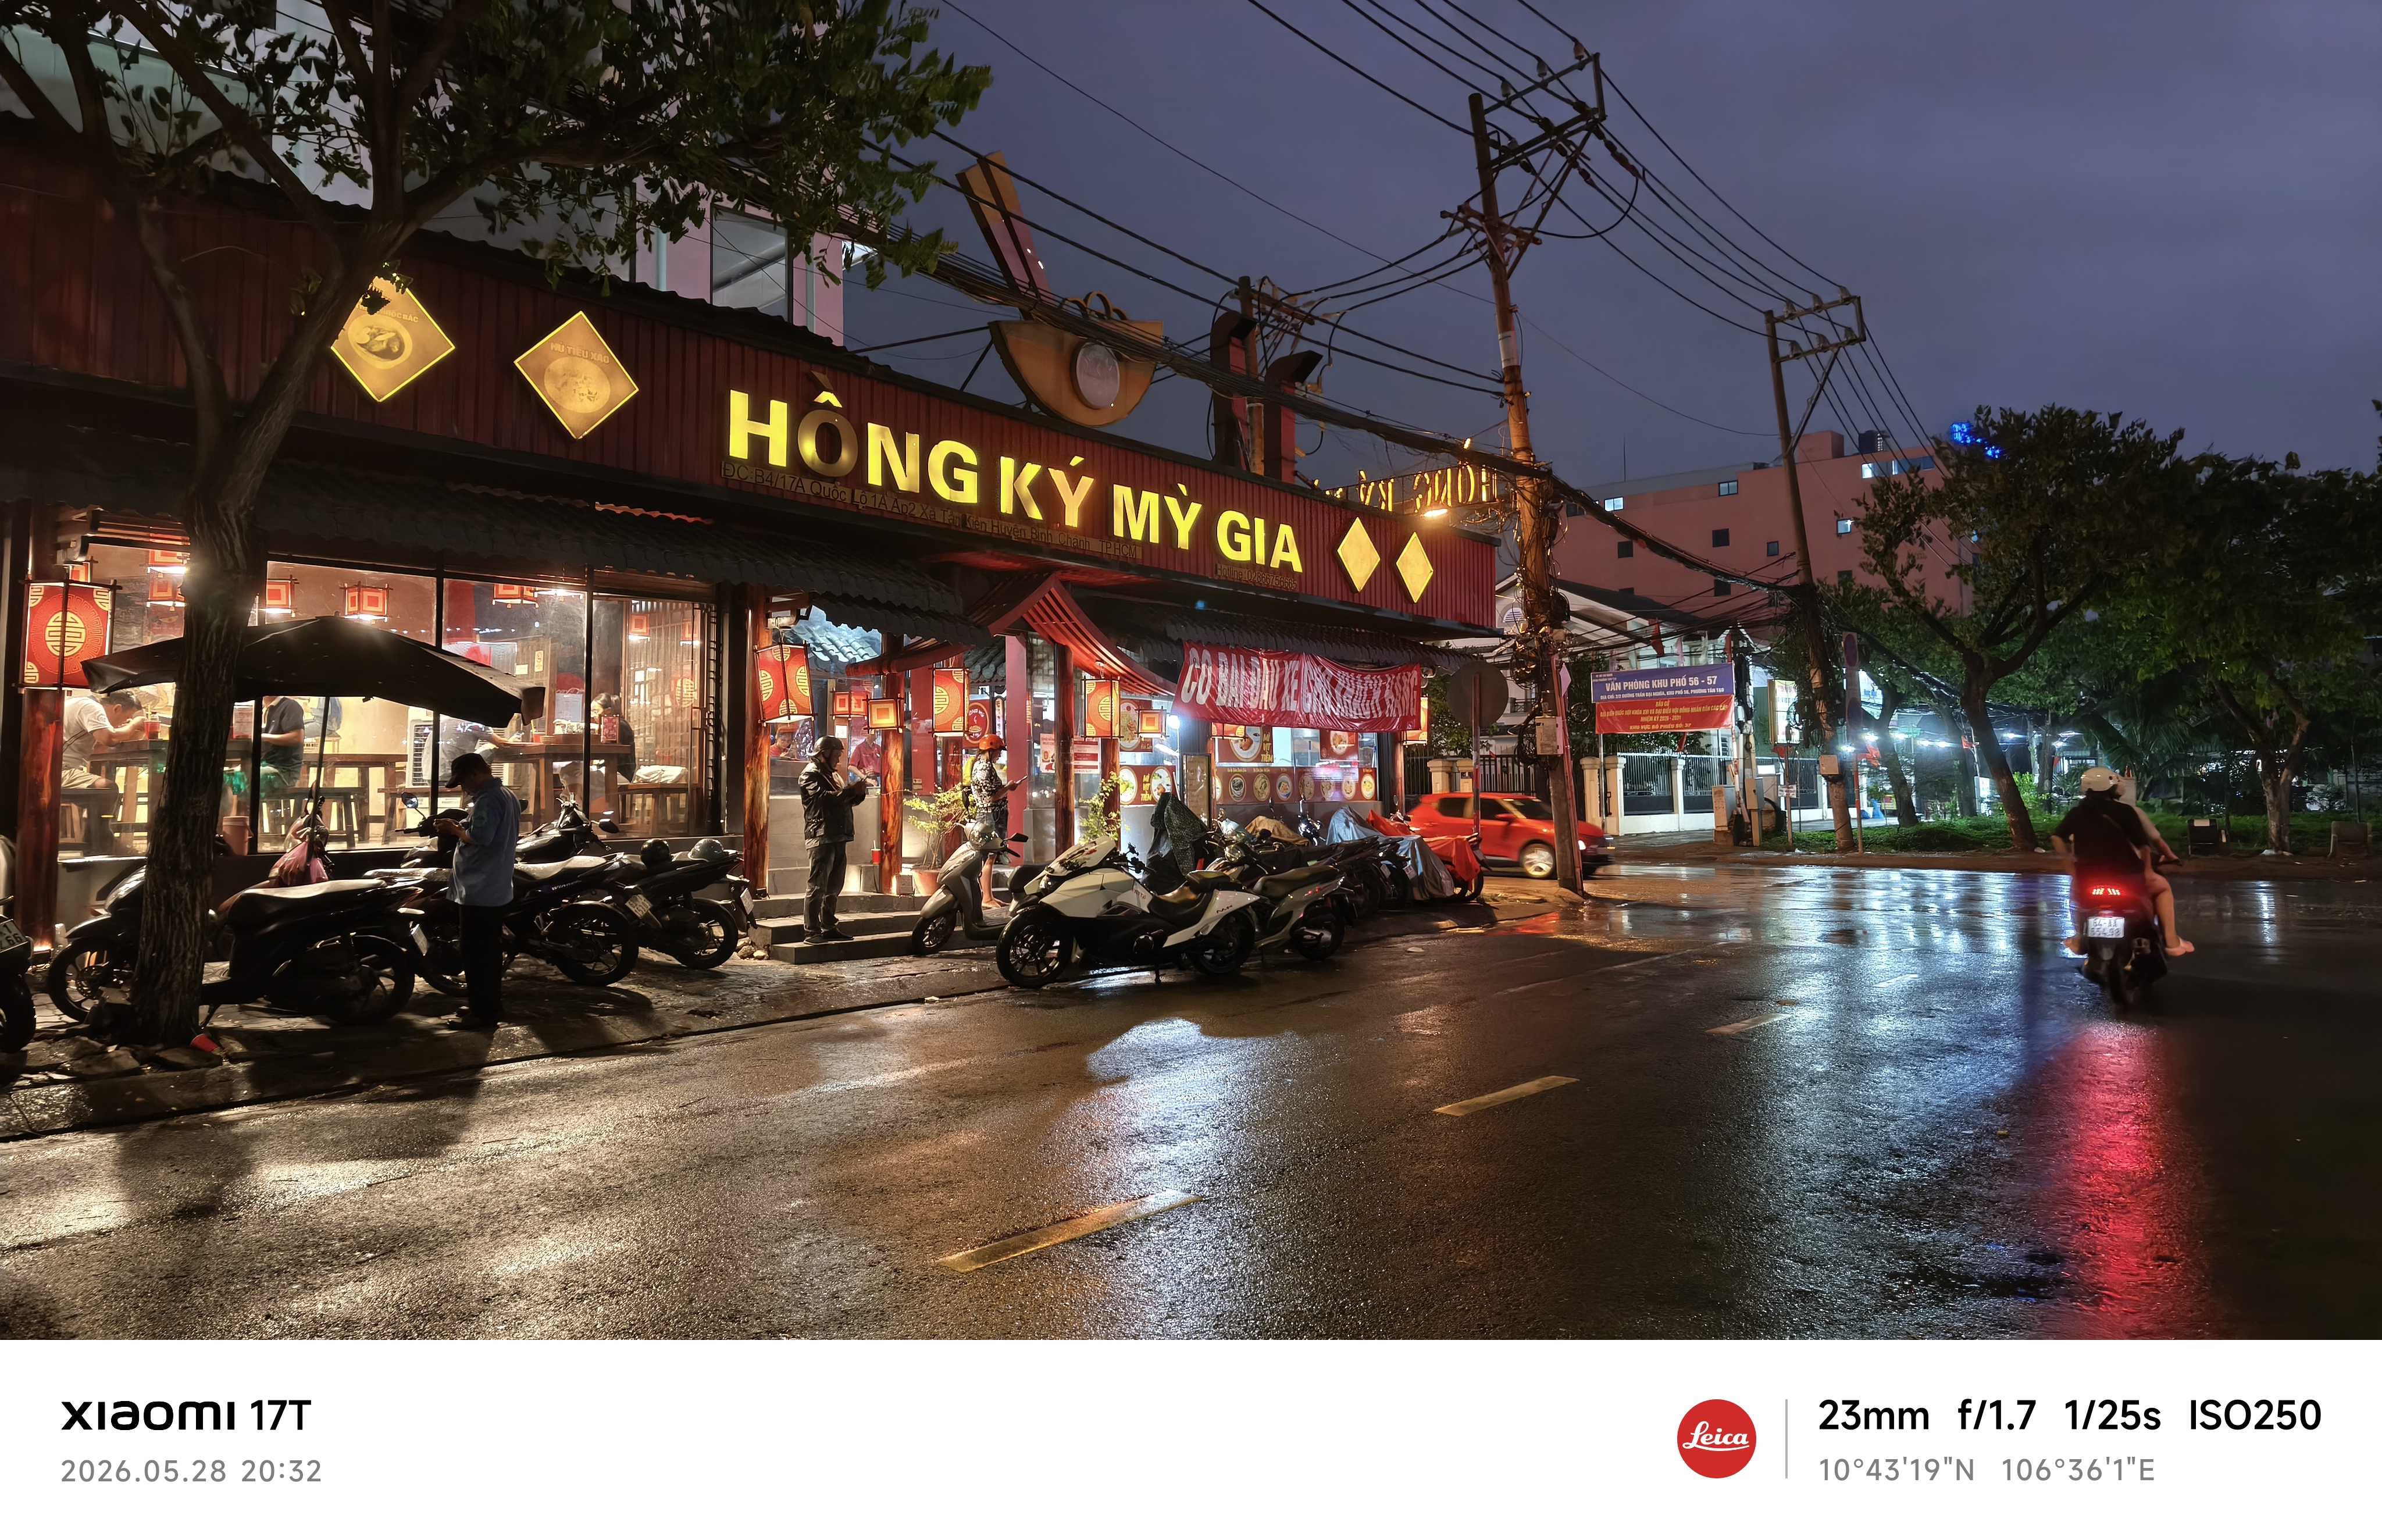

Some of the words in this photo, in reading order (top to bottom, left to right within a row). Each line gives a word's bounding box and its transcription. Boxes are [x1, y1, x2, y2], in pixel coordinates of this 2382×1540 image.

[729, 370, 978, 504] HỒNG
[1000, 455, 1094, 528] KÝ
[1113, 483, 1202, 550] MỲ
[1217, 510, 1303, 573] GIA
[1281, 660, 1300, 712] XE
[1623, 679, 1650, 690] PHÒNG
[1652, 679, 1668, 688] KHU
[1670, 675, 1687, 687] PHỐ
[1689, 676, 1699, 686] 56
[1707, 675, 1717, 685] 57
